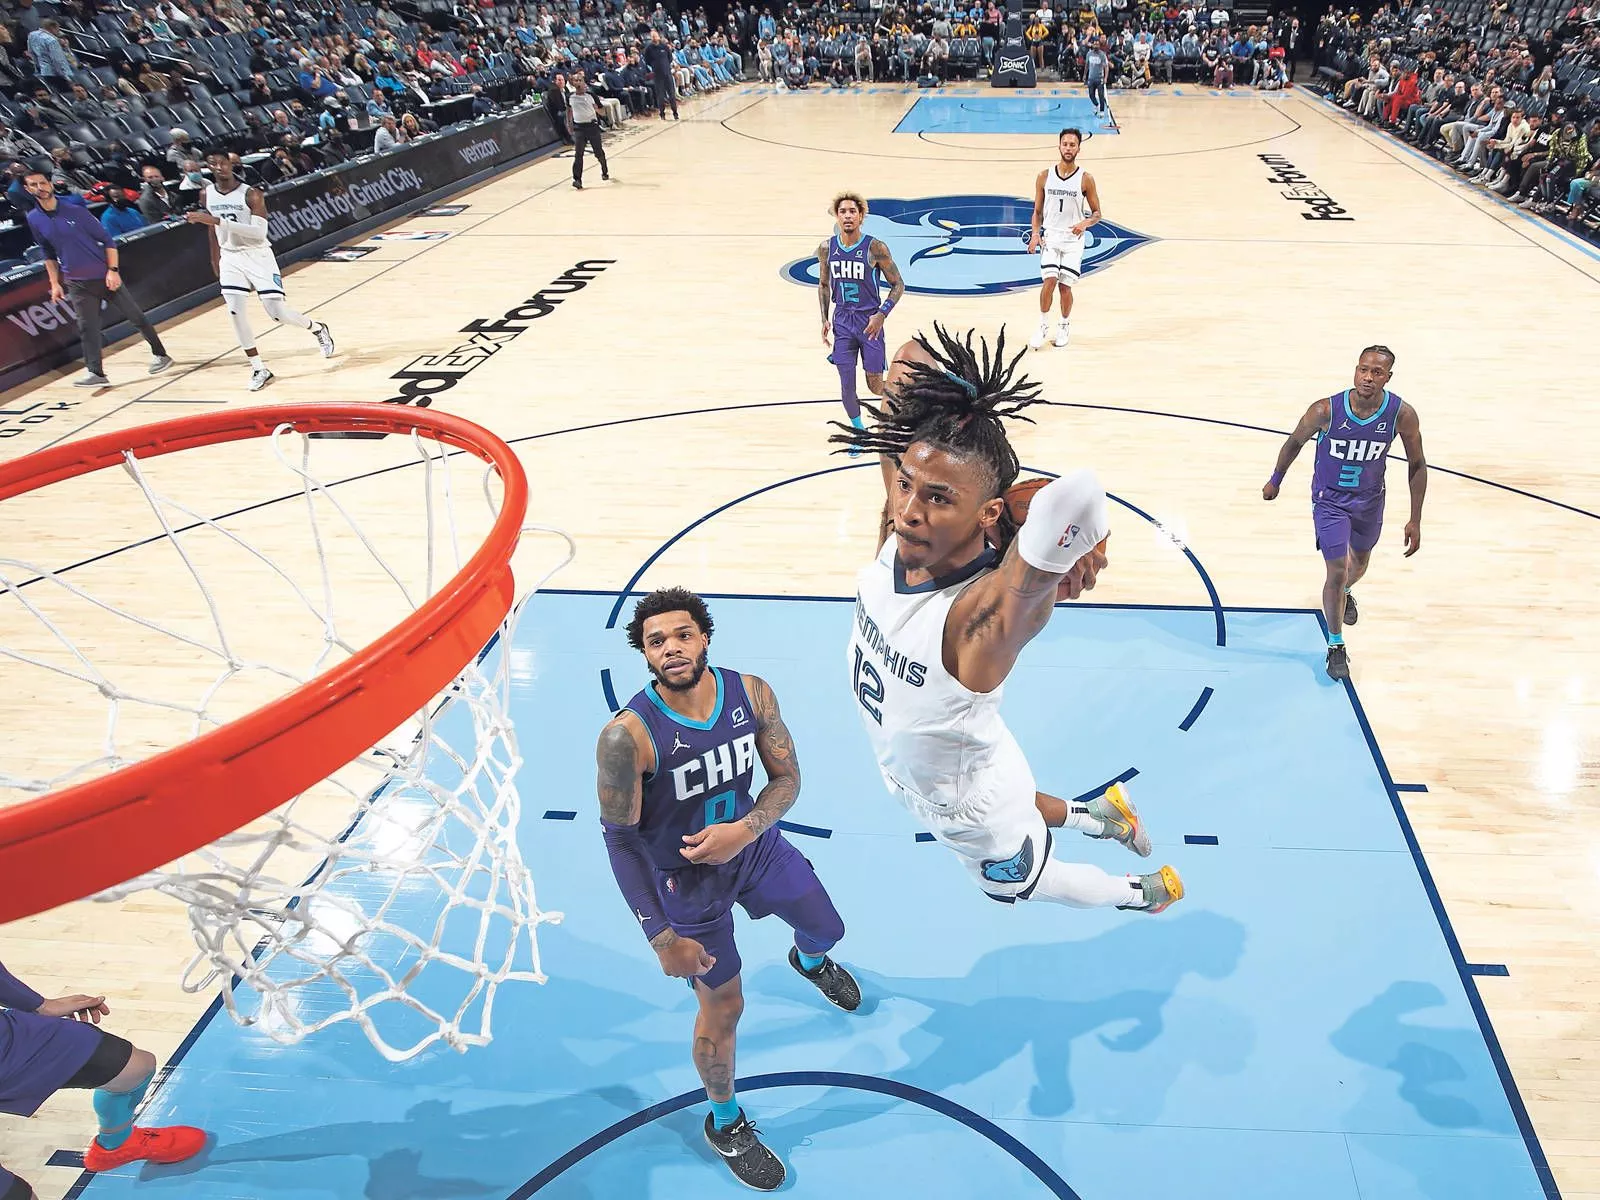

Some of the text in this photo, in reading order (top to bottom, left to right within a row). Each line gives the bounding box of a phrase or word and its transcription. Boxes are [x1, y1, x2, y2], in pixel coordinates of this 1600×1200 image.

[1002, 61, 1026, 69] SONIC
[459, 137, 501, 165] verizon
[1048, 188, 1077, 197] MEMPHIS
[1257, 154, 1356, 221] FedExForum
[268, 167, 424, 241] uilt right for Grind City.
[1059, 199, 1064, 212] 1
[830, 260, 865, 280] CHA
[839, 281, 860, 303] 12
[1330, 438, 1387, 461] CHA
[1338, 465, 1363, 487] 3
[855, 587, 928, 688] MEMPHIS
[853, 643, 885, 727] 12
[670, 732, 755, 801] CHA
